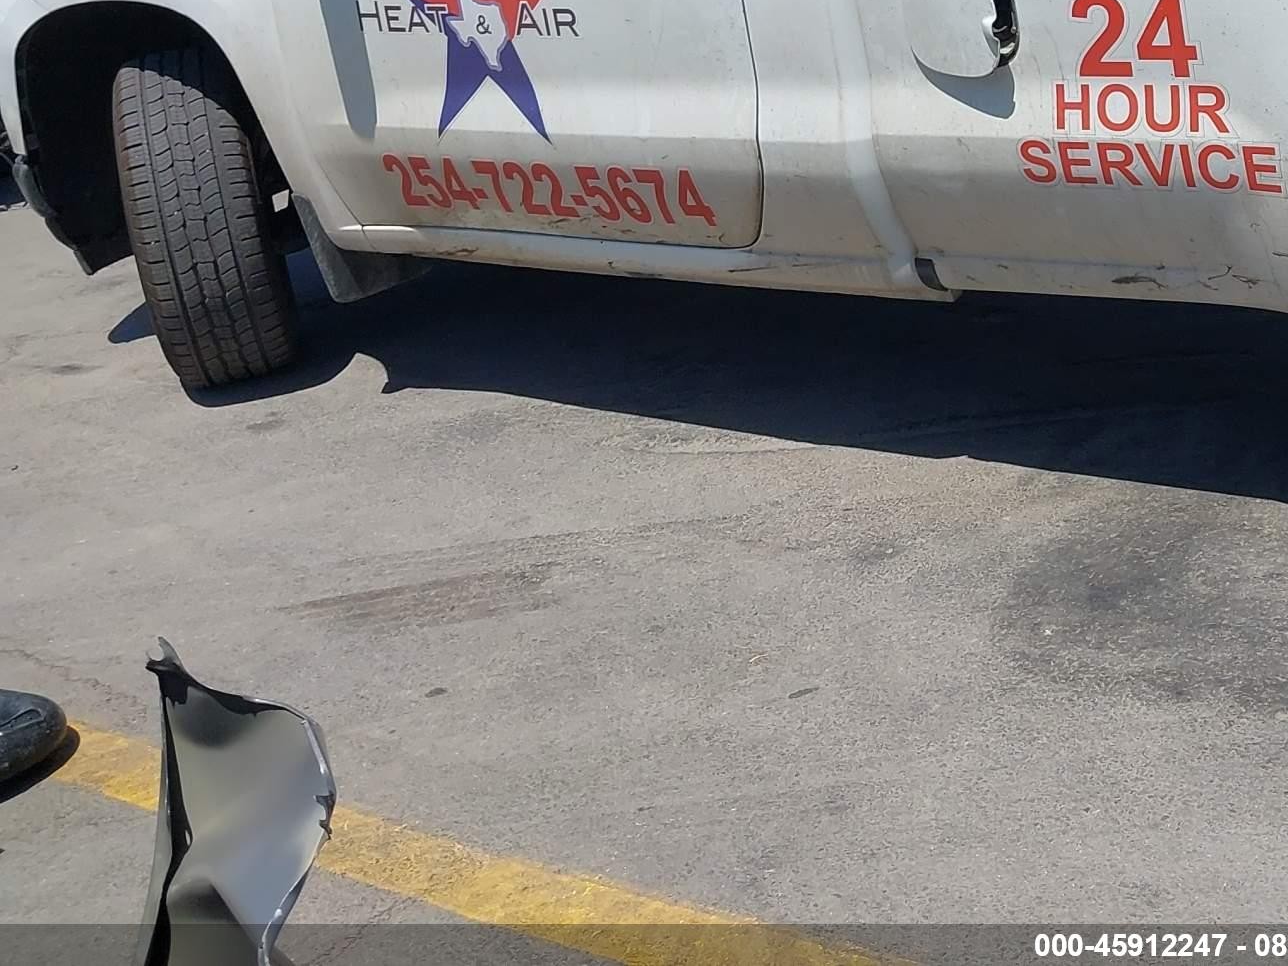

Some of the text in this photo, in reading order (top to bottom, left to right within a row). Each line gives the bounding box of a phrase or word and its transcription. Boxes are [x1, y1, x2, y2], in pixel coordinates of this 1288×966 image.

[356, 0, 581, 37] HEAT & AIR
[1054, 82, 1230, 134] HOUR
[382, 153, 717, 227] 254-722-5674
[1018, 139, 1283, 194] SERVICE
